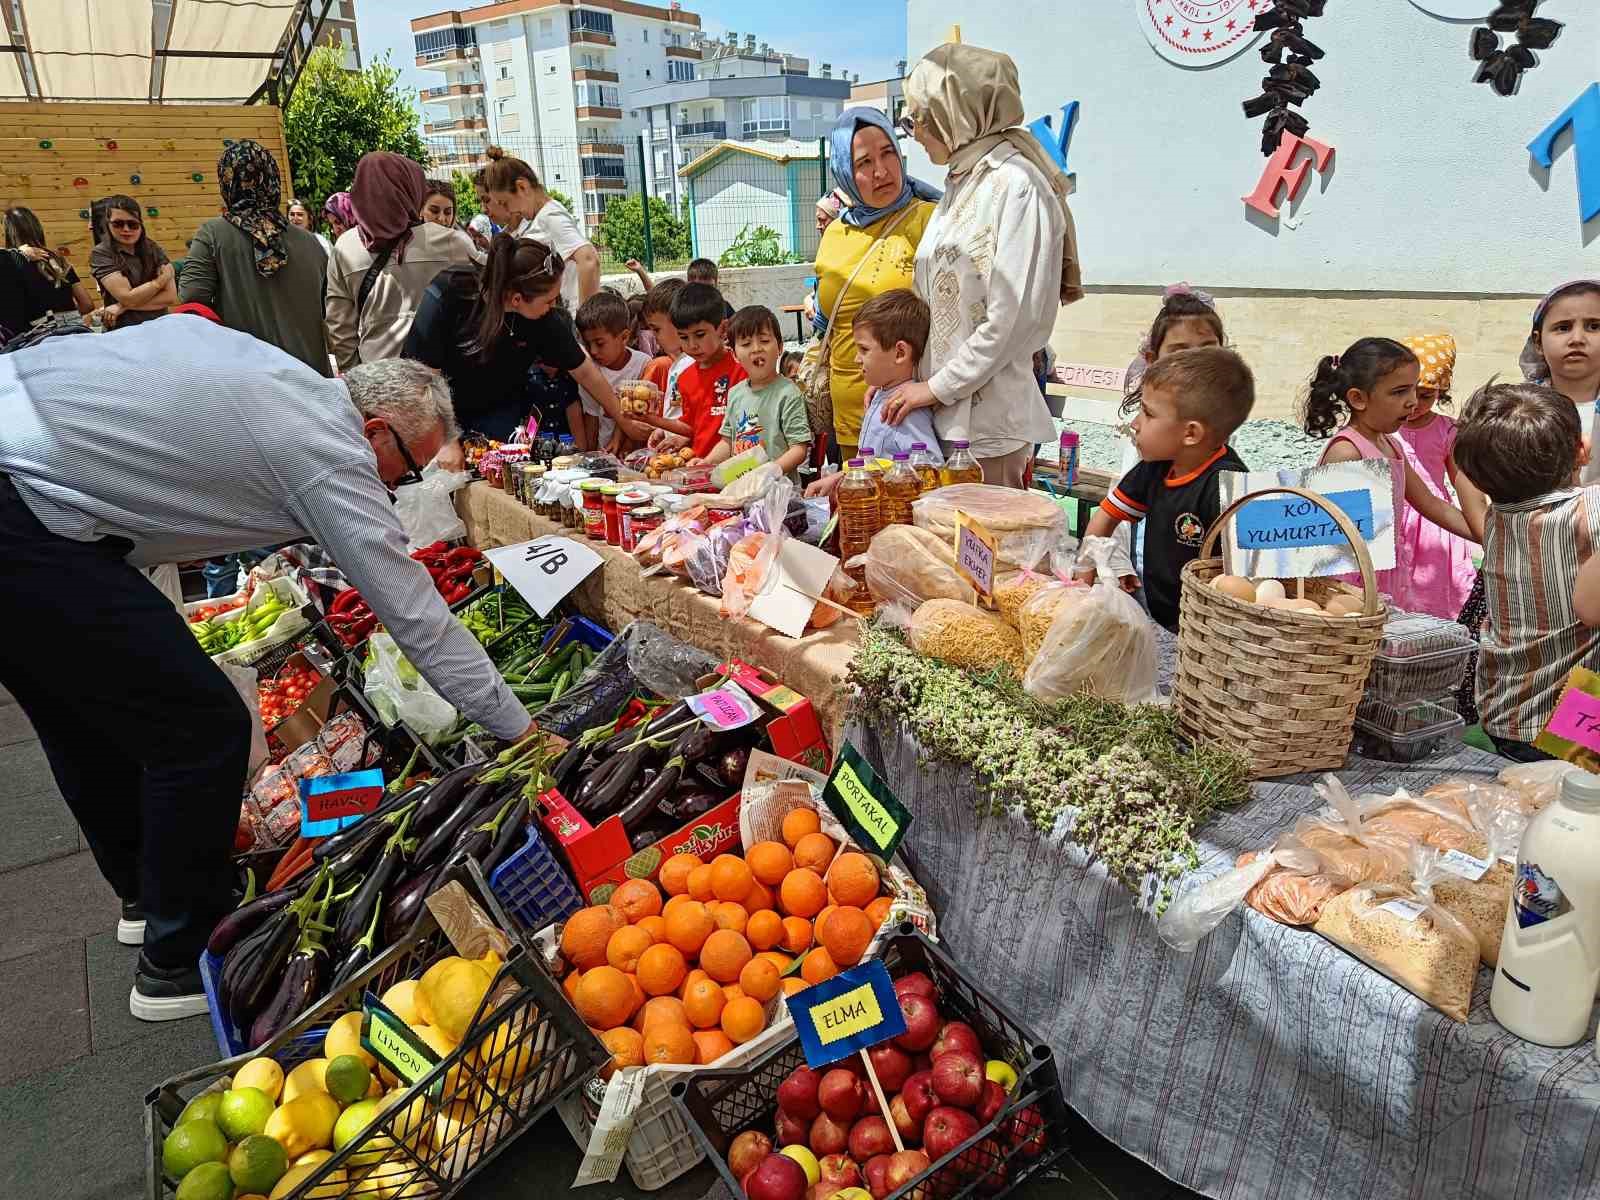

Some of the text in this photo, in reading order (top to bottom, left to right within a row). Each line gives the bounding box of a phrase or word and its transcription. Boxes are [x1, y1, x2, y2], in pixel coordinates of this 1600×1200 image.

[1247, 518, 1365, 543] YUMURTAI
[524, 543, 569, 575] 4/B
[840, 771, 889, 835] PORTAKAL
[822, 1000, 867, 1029] ELMA
